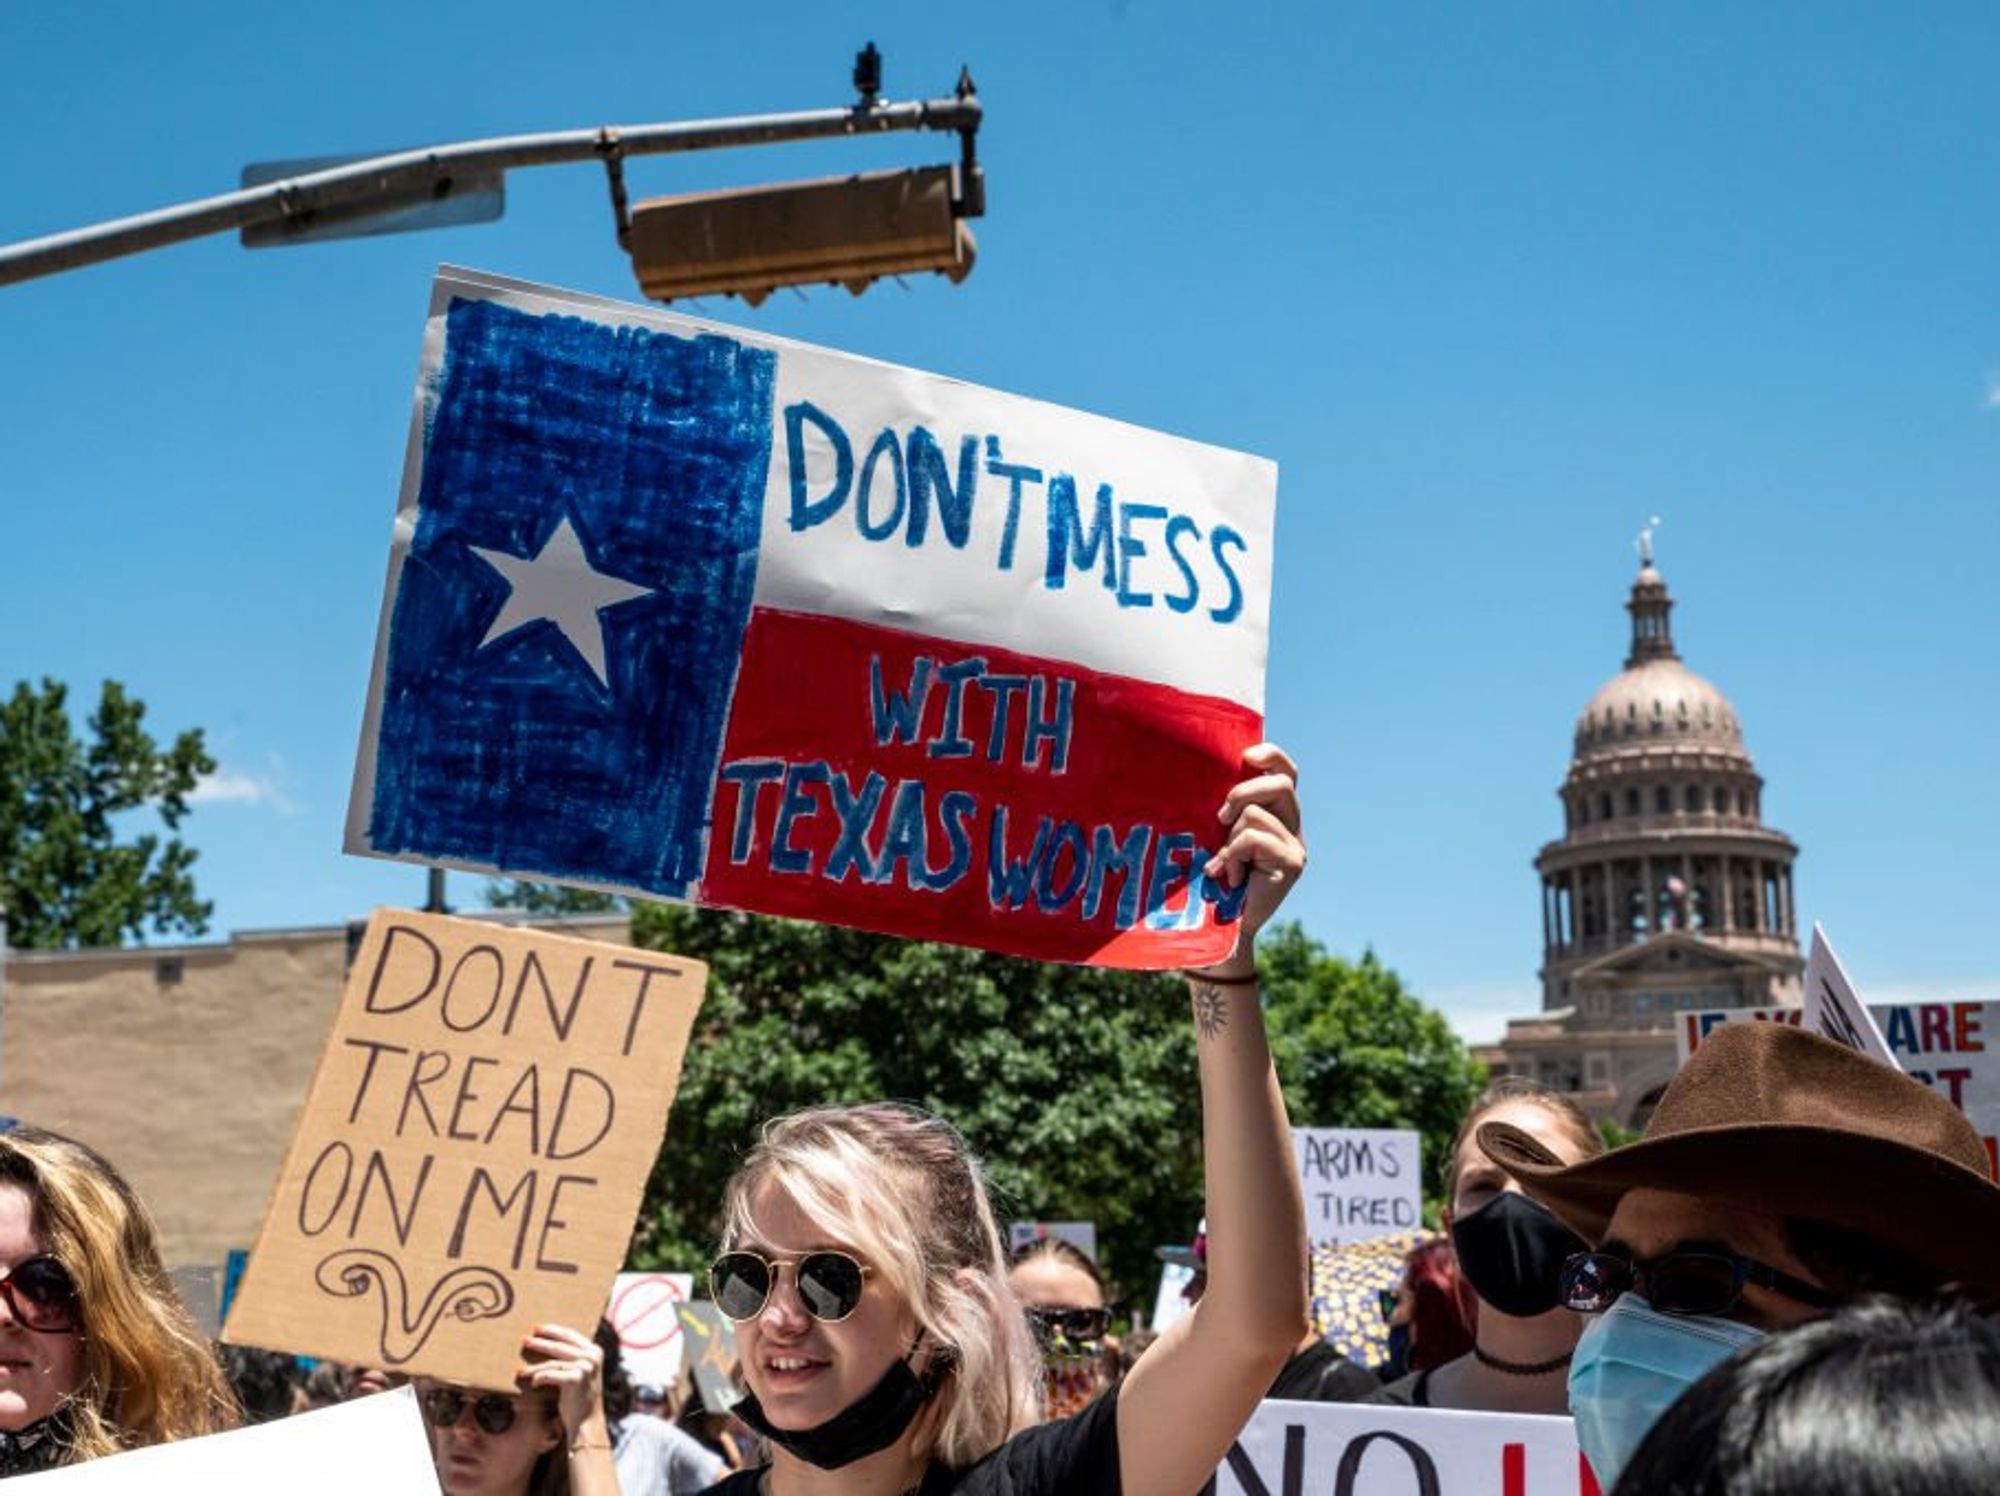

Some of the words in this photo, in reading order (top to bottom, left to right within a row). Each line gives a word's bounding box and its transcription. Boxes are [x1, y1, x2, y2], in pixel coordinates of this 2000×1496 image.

[785, 401, 1043, 570] DON'T
[1045, 472, 1247, 623] MESS
[870, 653, 1077, 775] WITH
[719, 757, 977, 891] TEXAS
[987, 804, 1246, 931] WOMEN
[365, 925, 683, 1056] DONT
[1887, 1003, 1985, 1054] ARE
[345, 1038, 616, 1160] TREAD
[1303, 1134, 1400, 1182] ARMS
[299, 1141, 435, 1248] ON
[447, 1166, 598, 1275] ME
[1316, 1192, 1416, 1227] TIRED
